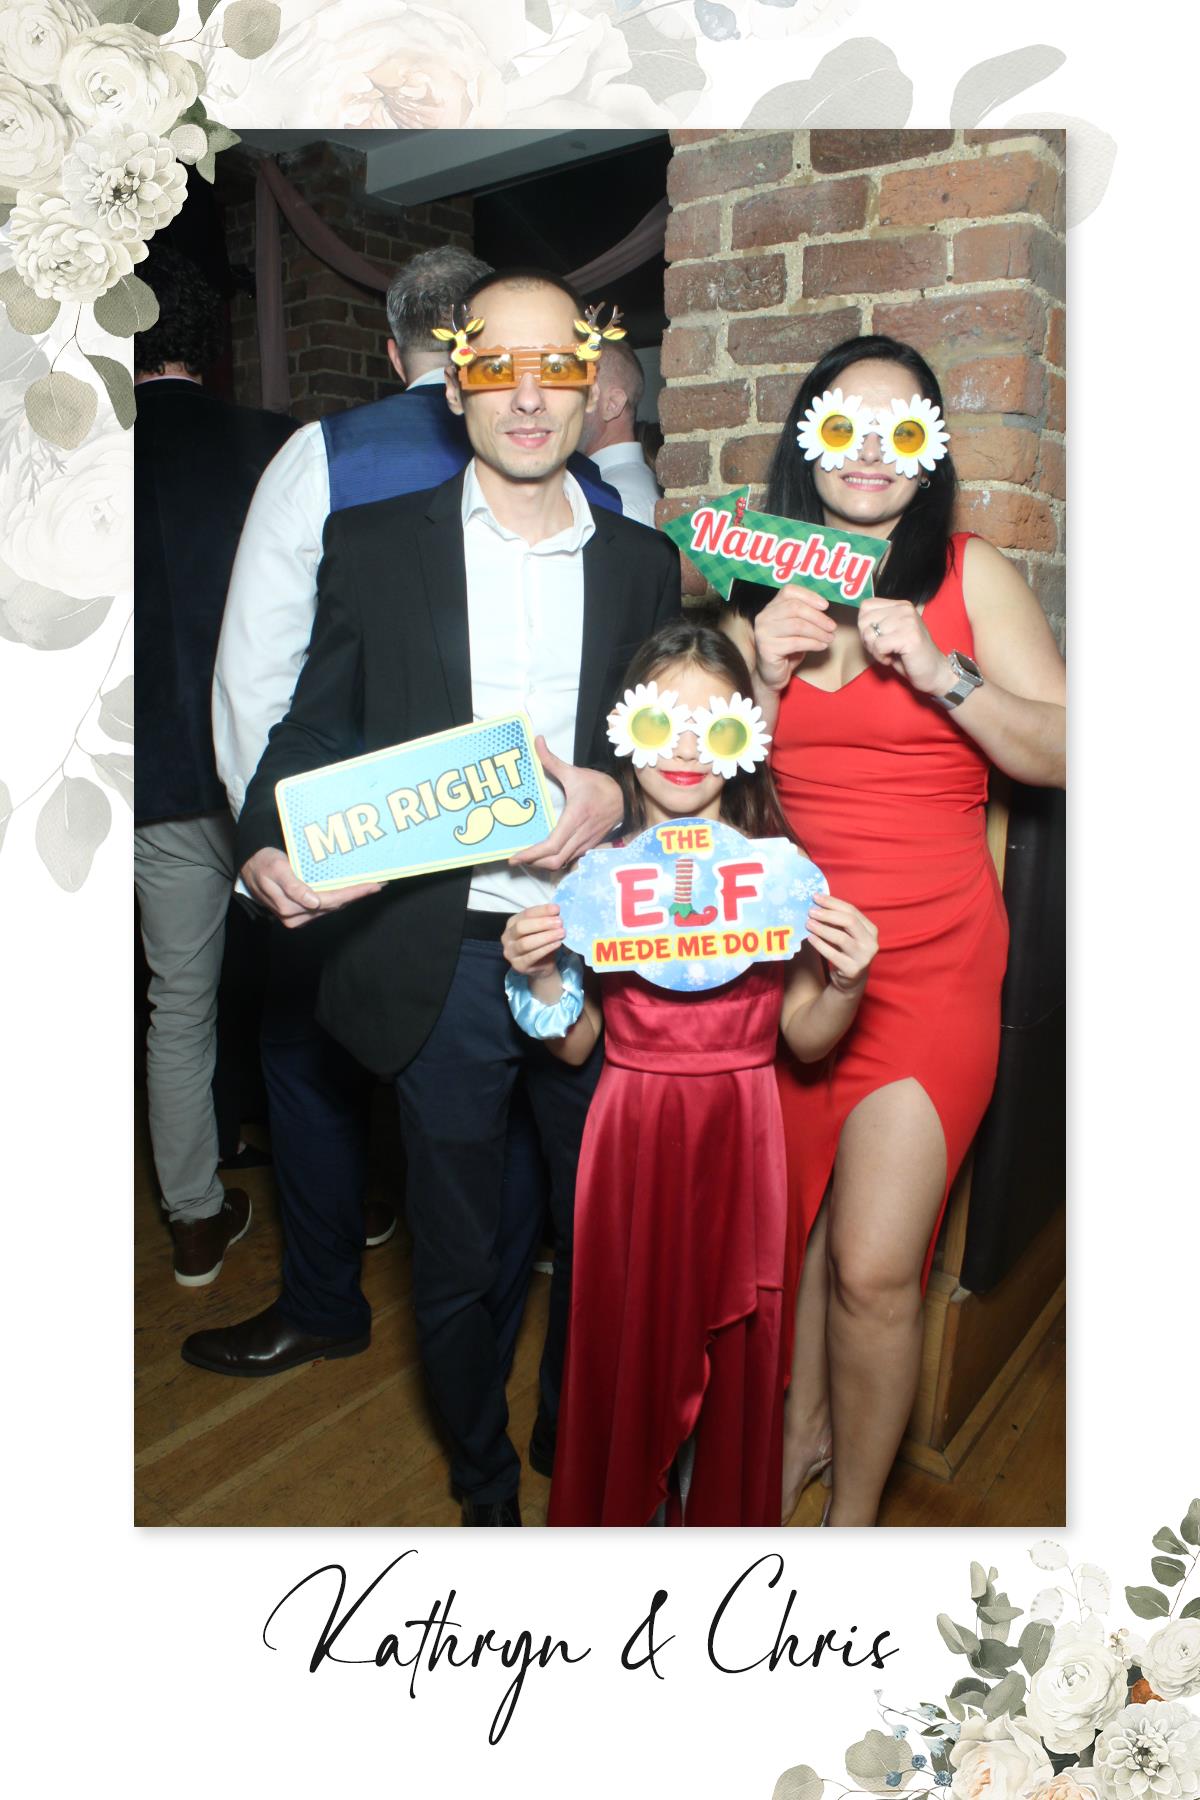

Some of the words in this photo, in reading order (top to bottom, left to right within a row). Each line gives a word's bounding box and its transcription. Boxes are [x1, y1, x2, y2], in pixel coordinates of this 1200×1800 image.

[693, 510, 872, 597] Naughty
[303, 803, 387, 863] MR
[385, 747, 523, 833] RIGHT
[660, 828, 710, 850] THE
[615, 858, 765, 928] ELF
[595, 938, 671, 962] MEDE
[677, 935, 716, 957] ME
[723, 932, 759, 954] DO
[766, 929, 790, 951] IT
